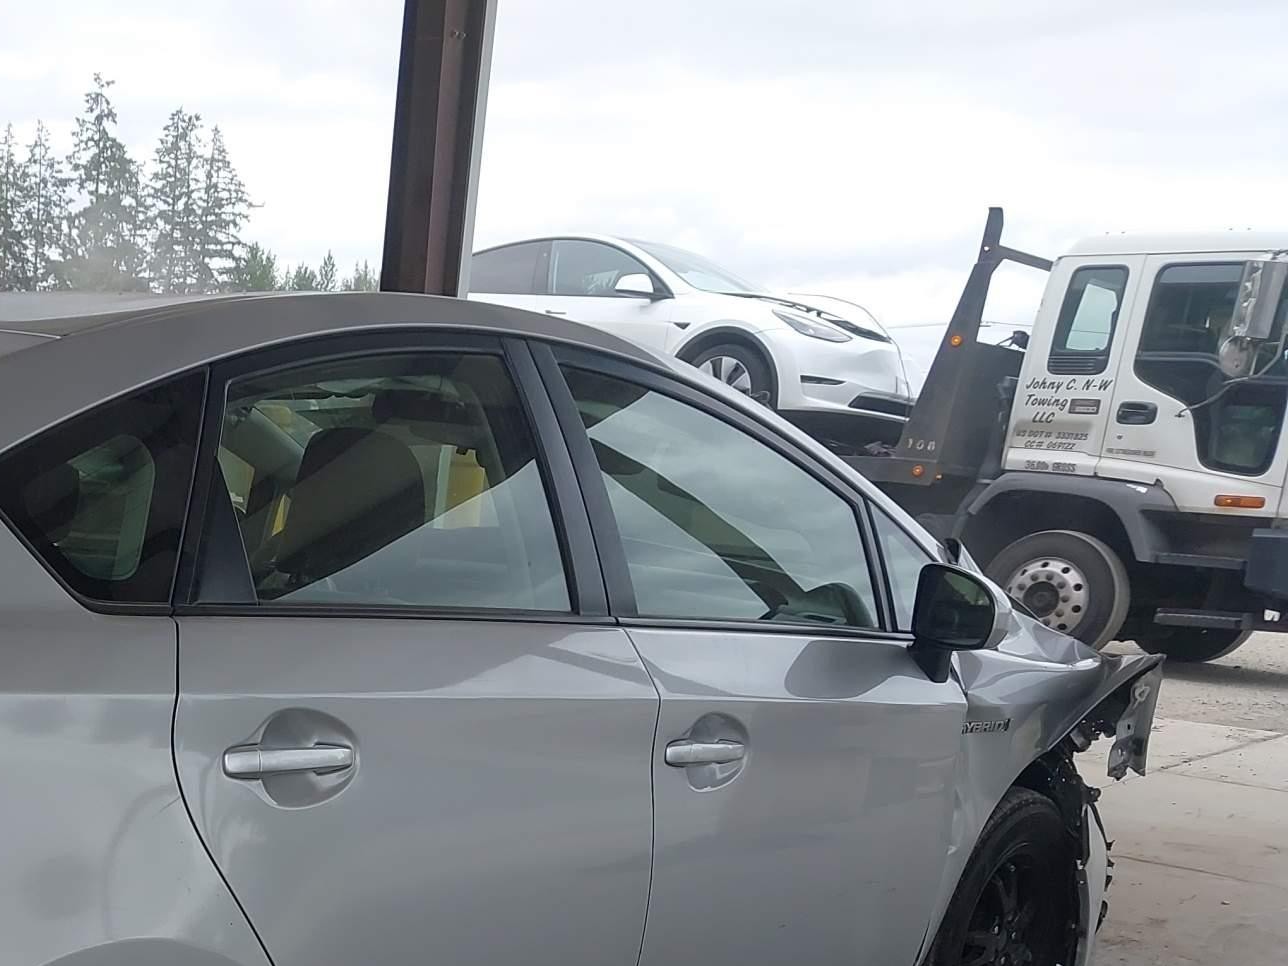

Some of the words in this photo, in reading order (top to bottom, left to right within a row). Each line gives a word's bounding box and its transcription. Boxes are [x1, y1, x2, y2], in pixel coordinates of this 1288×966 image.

[1025, 377, 1063, 394] Johny
[1066, 378, 1077, 391] C.
[1082, 378, 1113, 391] N-W
[1024, 394, 1069, 412] Towing
[1032, 411, 1055, 424] LLC
